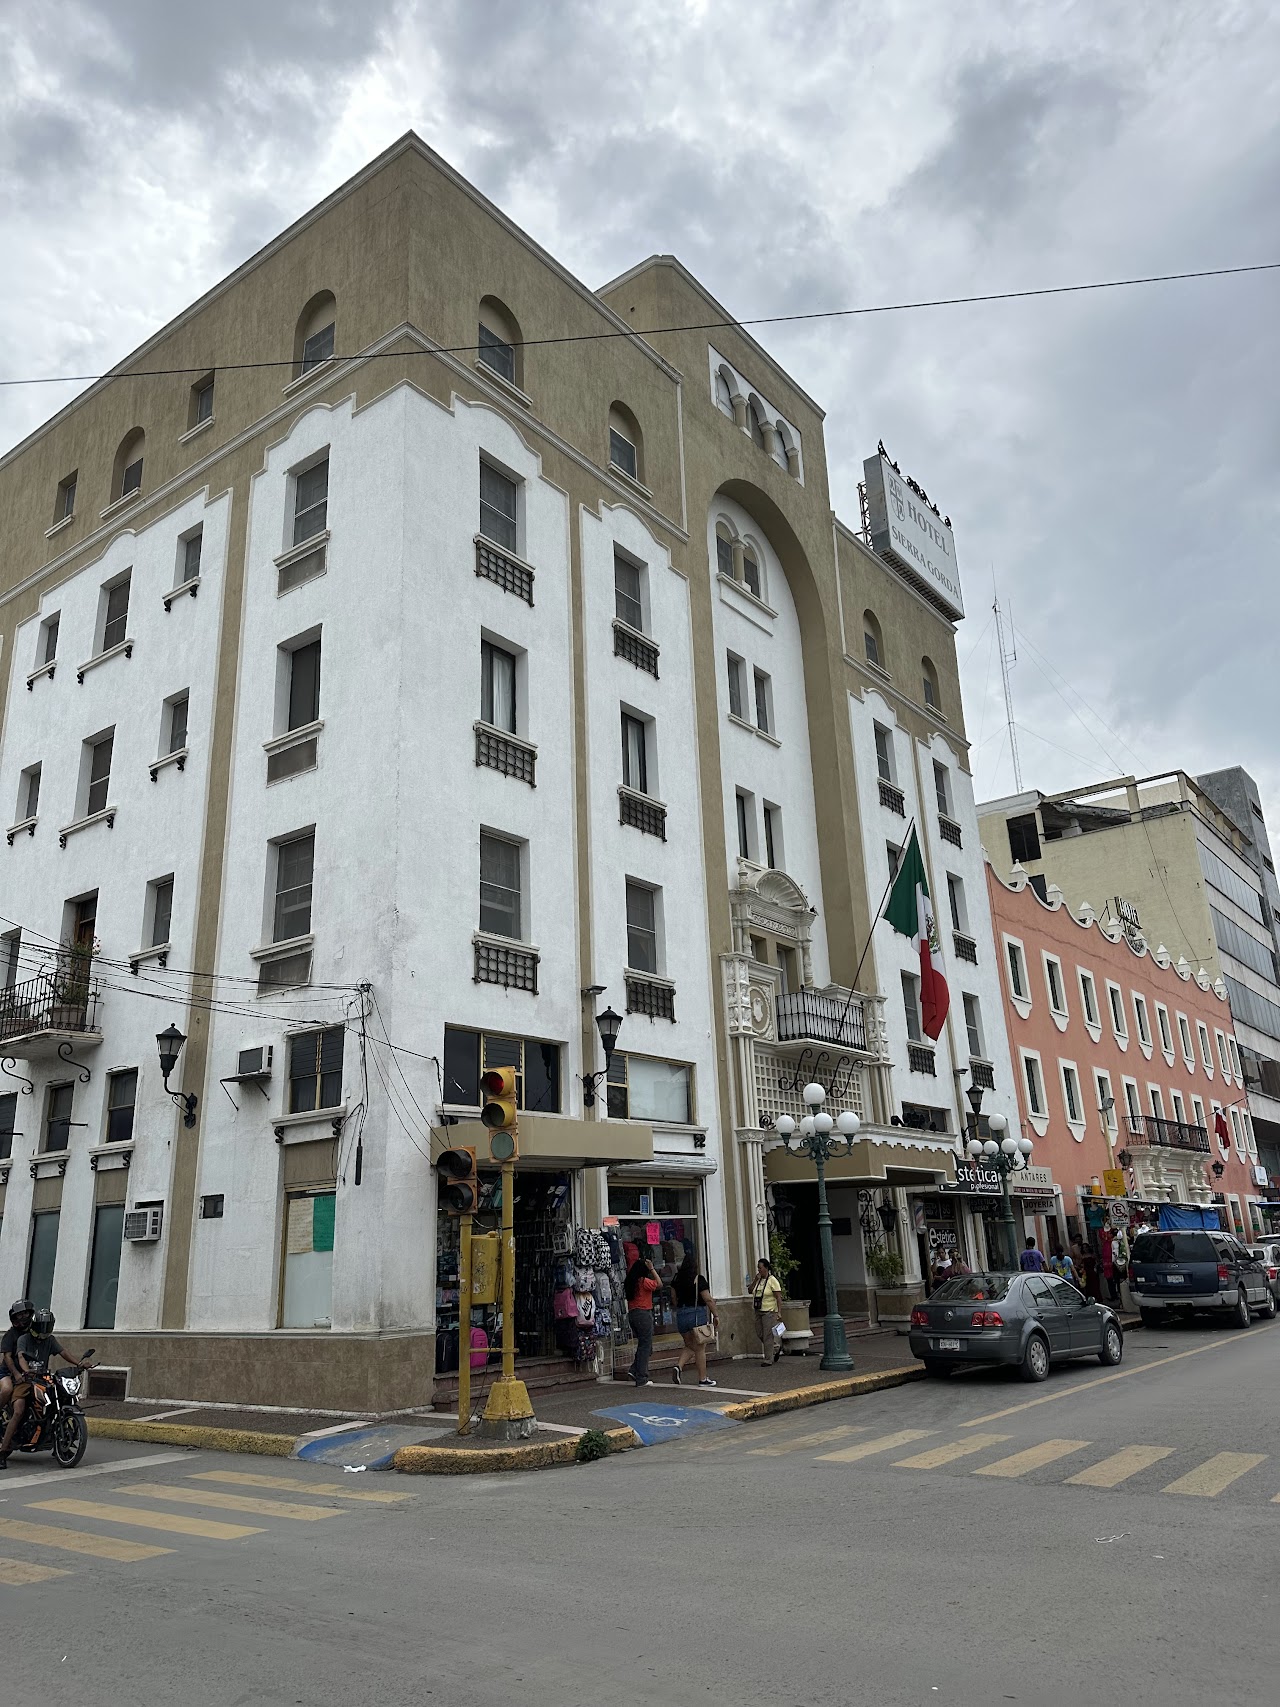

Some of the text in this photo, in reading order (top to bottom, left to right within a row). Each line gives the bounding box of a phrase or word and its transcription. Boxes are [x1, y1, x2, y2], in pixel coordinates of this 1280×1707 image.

[907, 500, 950, 556] HOTEL
[892, 526, 959, 599] SIERRA GORDA
[1119, 897, 1139, 926] HOTEL
[1021, 1172, 1047, 1183] ANTARES
[929, 1228, 957, 1247] estética
